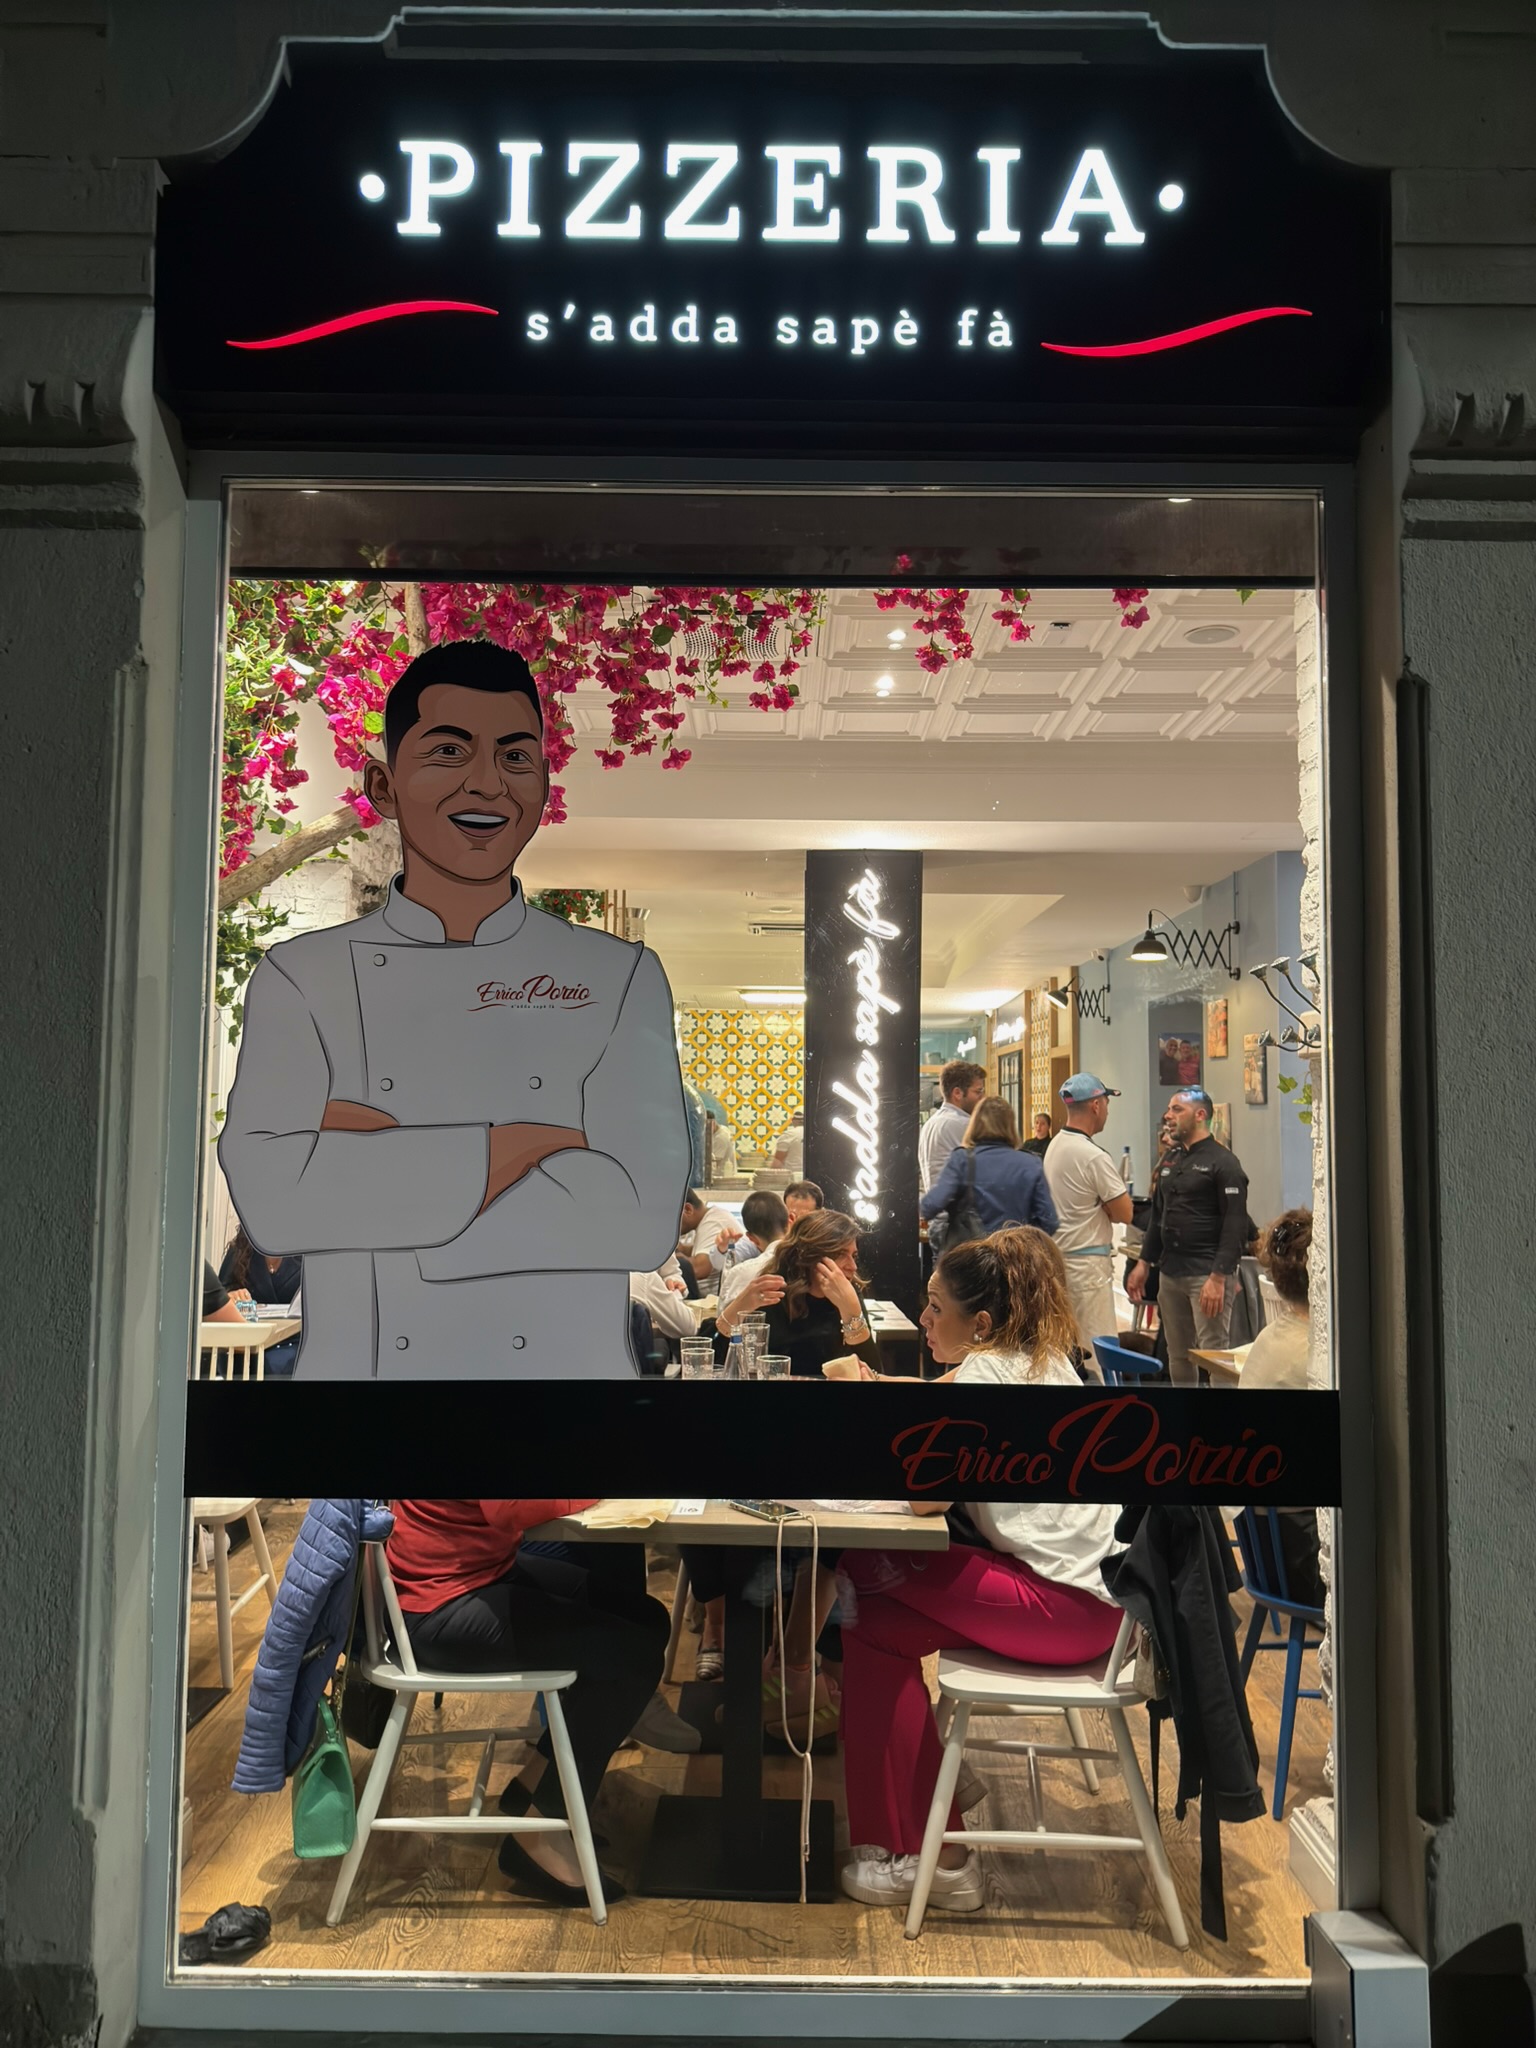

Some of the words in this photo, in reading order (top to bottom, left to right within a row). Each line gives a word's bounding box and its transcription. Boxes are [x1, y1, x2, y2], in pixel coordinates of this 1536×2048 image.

[397, 139, 1147, 246] PIZZERIA
[775, 308, 919, 356] sapè
[956, 307, 1014, 348] fà
[842, 867, 901, 940] fà
[477, 981, 524, 1002] Errico
[522, 974, 590, 1003] Porzio
[843, 937, 901, 1050] sapè
[891, 1416, 1055, 1491] Errico
[1048, 1394, 1288, 1497] Porzio
